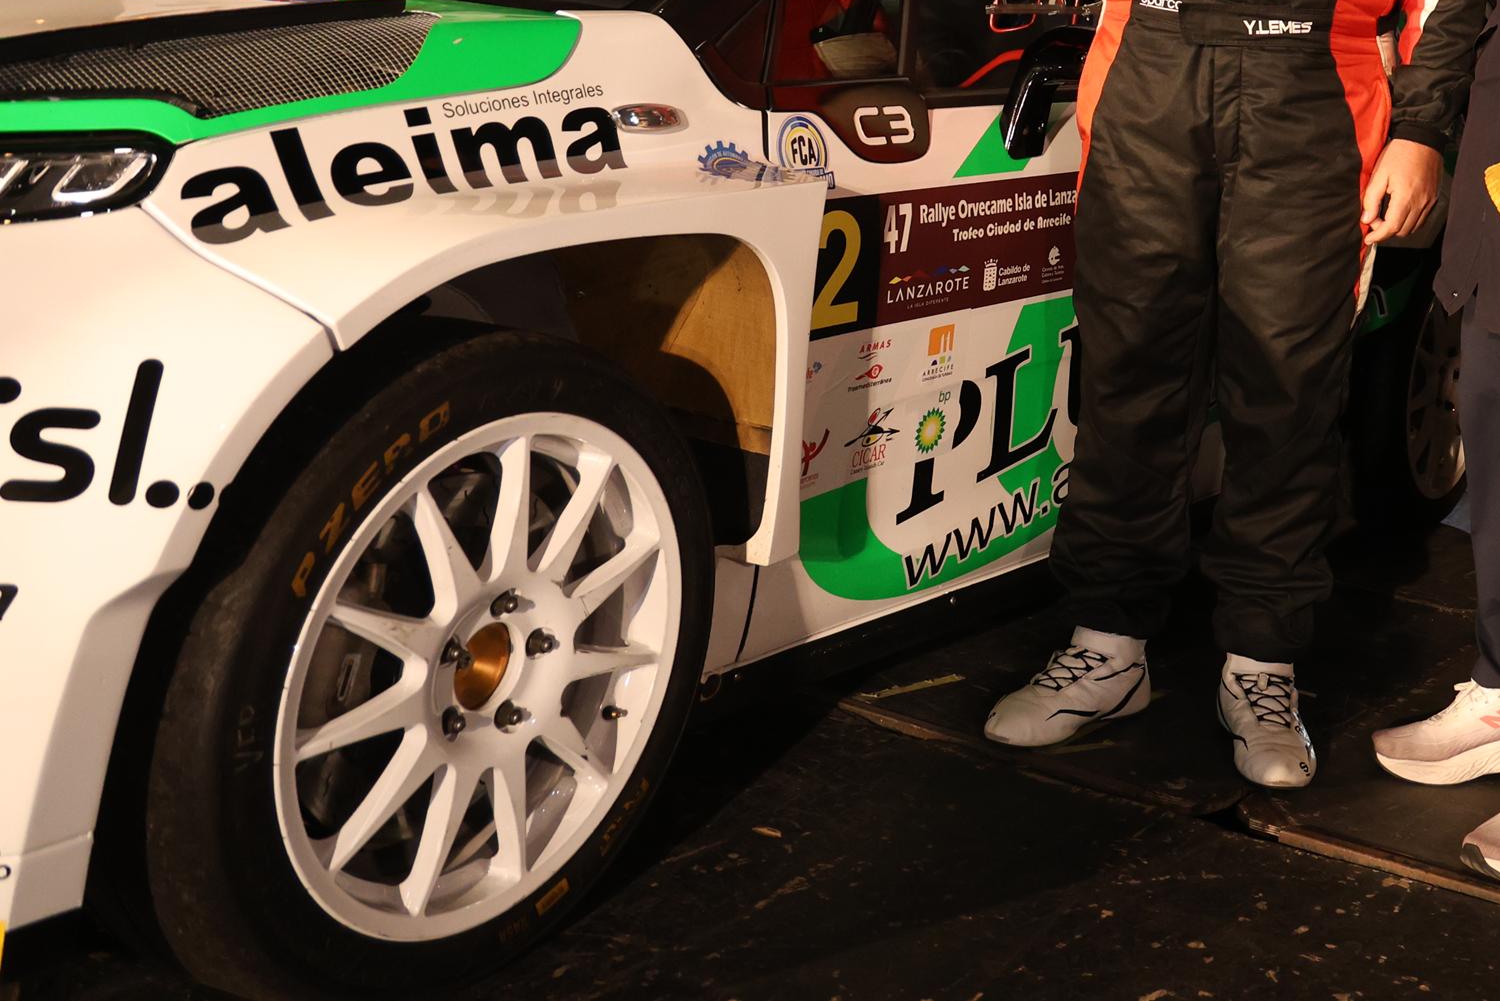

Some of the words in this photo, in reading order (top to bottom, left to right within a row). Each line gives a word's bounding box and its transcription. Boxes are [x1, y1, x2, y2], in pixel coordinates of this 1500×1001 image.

[1243, 20, 1313, 36] Y.LEMES
[442, 92, 529, 119] Soluciones
[533, 83, 604, 106] Integrales
[853, 105, 915, 146] C3
[790, 135, 817, 166] FCA
[180, 105, 628, 245] aleima
[883, 203, 913, 254] 47
[920, 200, 956, 227] Rallye
[958, 196, 1013, 220] Orvecame
[1015, 192, 1033, 211] Isla
[1035, 190, 1047, 209] de
[1049, 188, 1077, 207] Lanza
[952, 225, 984, 242] Trofeo
[986, 219, 1022, 237] Ciudad
[1023, 218, 1035, 231] de
[1037, 213, 1072, 230] Arrecife
[810, 209, 862, 331] 2
[998, 274, 1028, 286] Lanzarote
[999, 265, 1022, 276] Cabildo
[1023, 263, 1031, 273] de
[887, 275, 970, 304] LANZAROTE
[859, 339, 892, 354] ARMAS
[939, 391, 951, 405] bp
[852, 443, 886, 468] CICAR
[902, 463, 1070, 588] www.a
